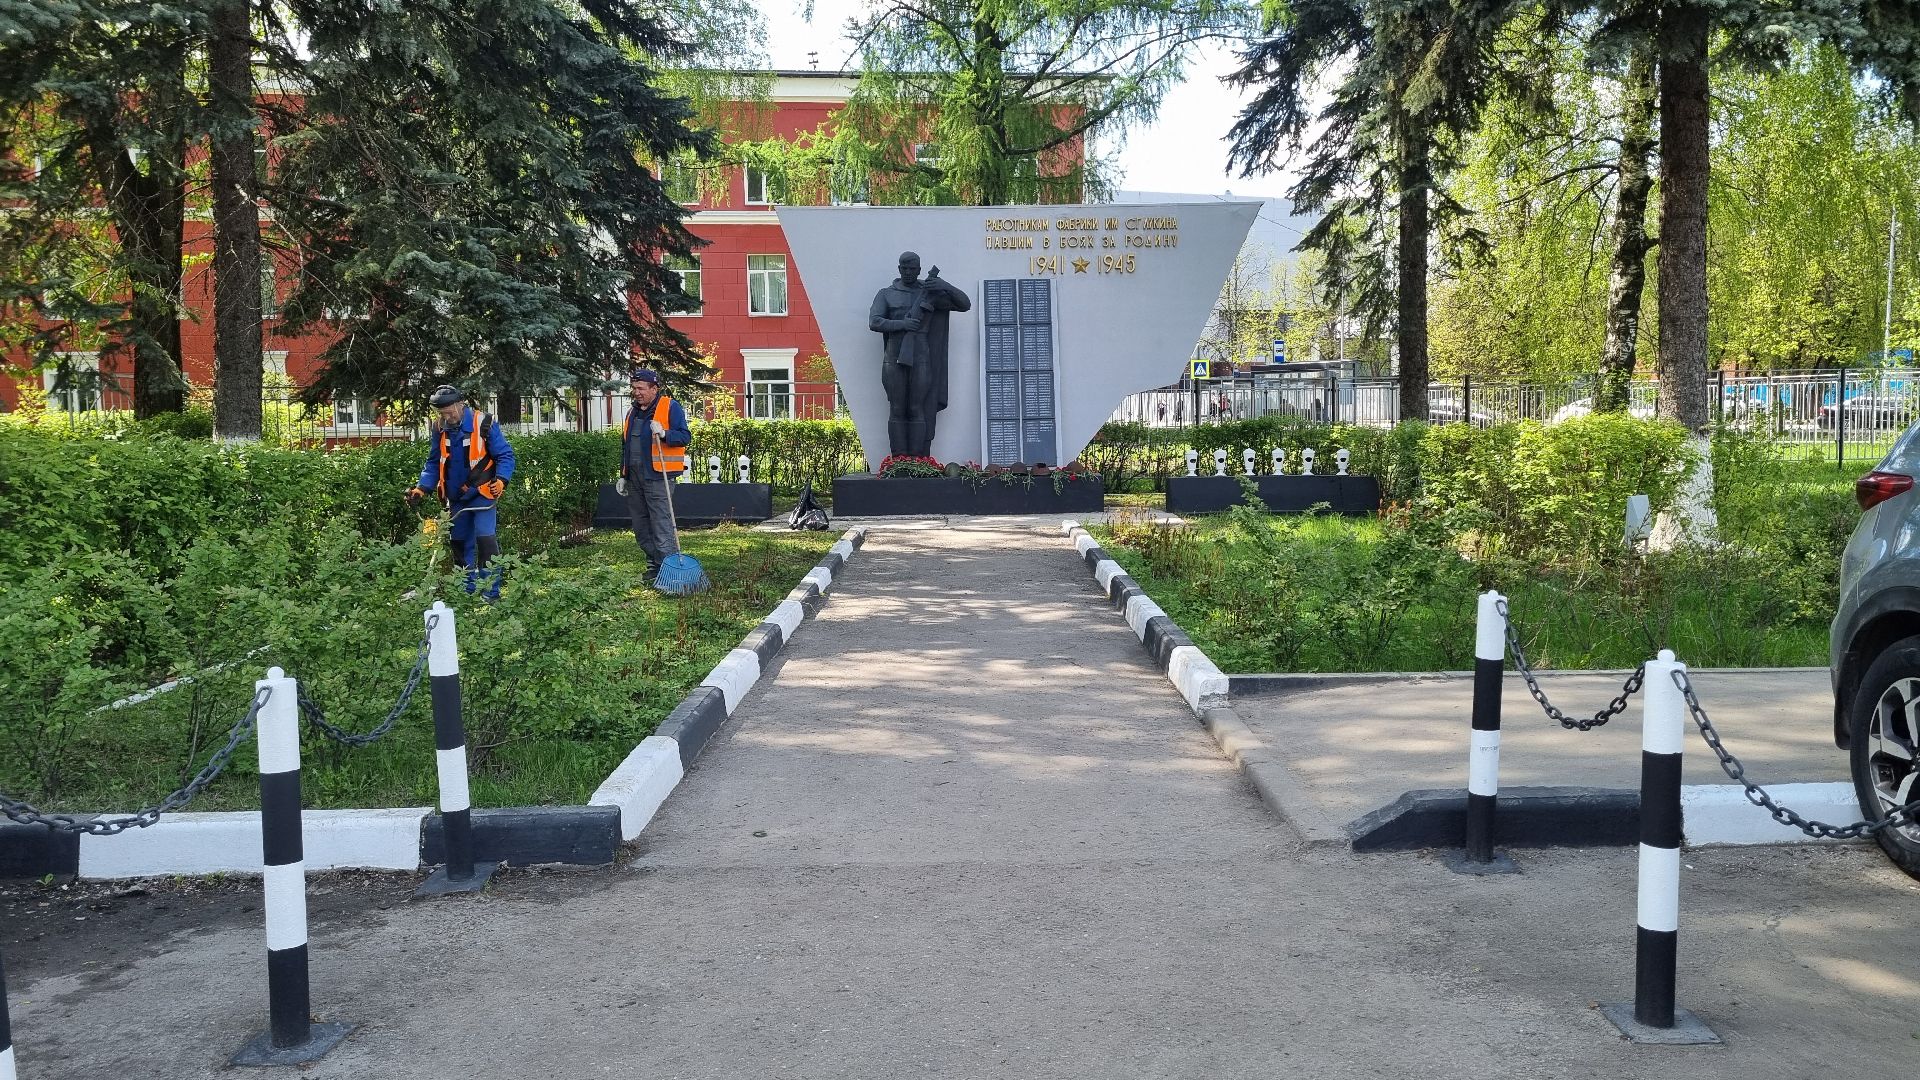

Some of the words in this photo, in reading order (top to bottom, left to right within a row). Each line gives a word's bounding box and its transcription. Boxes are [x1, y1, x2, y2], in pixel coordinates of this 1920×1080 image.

[986, 217, 1049, 231] РАБОТНИКАМ
[1056, 217, 1099, 231] ФАБРИКИ
[986, 234, 1034, 249] ПАВШИМ
[1043, 234, 1050, 248] В
[1060, 234, 1095, 248] БОЯХ
[1103, 234, 1117, 248] ЗА
[1125, 233, 1178, 248] РОДИНУ
[1029, 255, 1065, 275] 1941
[1097, 254, 1136, 275] 1945
